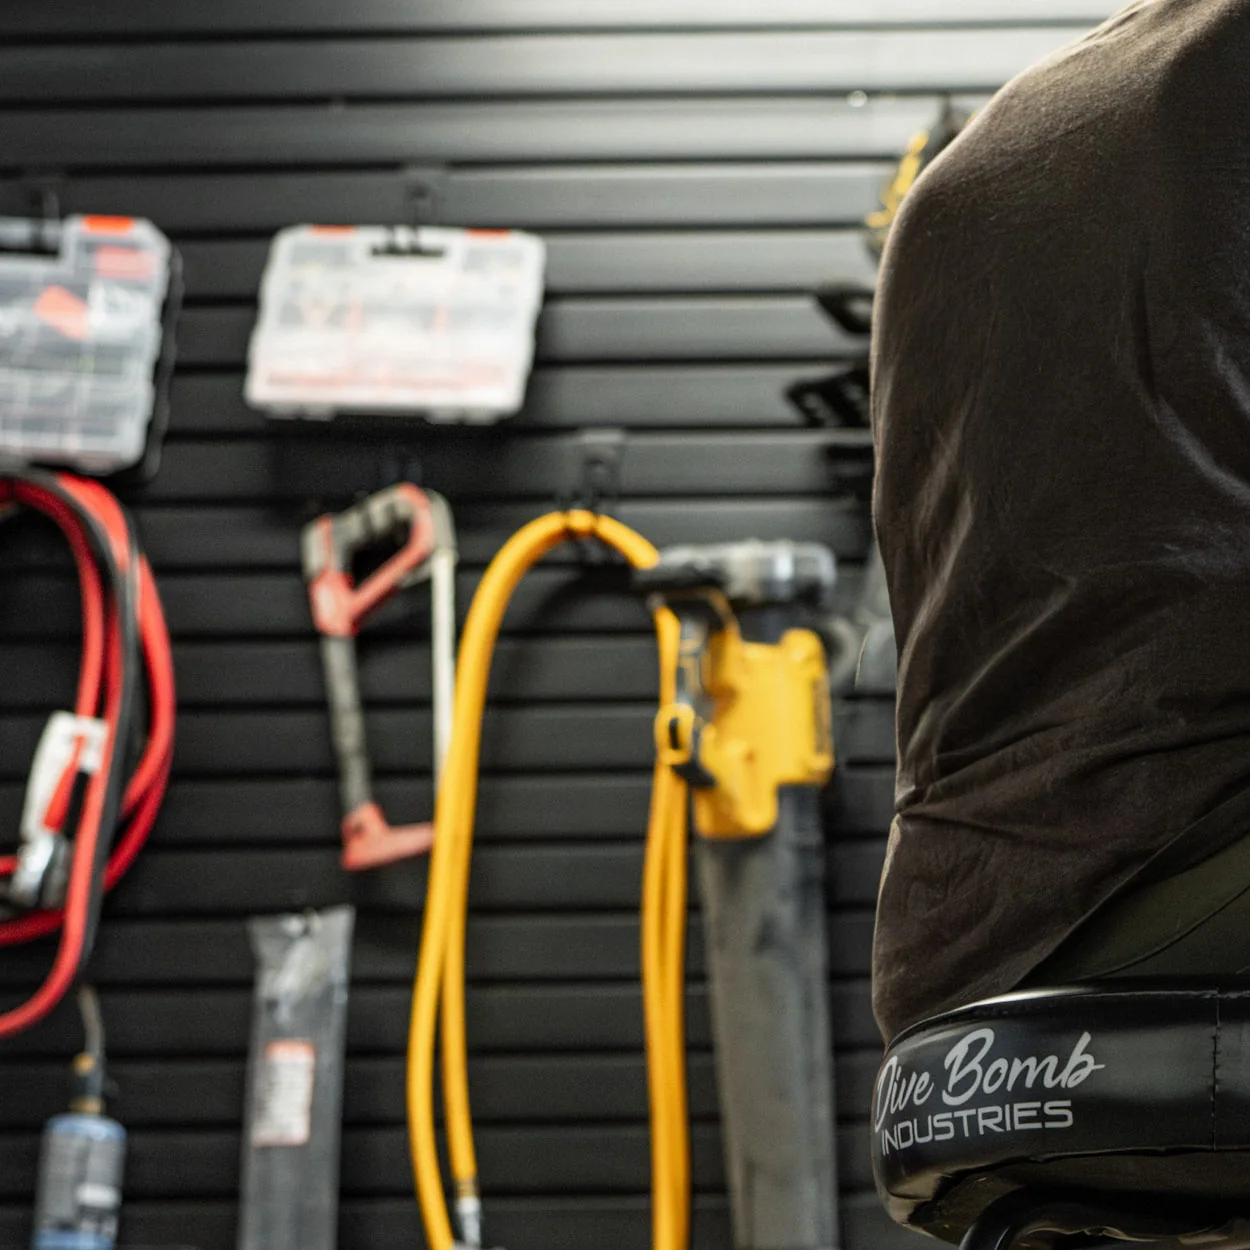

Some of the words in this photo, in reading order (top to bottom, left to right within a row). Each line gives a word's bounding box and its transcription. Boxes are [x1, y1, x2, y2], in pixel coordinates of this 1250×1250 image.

[874, 1055, 934, 1134] Dive
[942, 1027, 1106, 1106] Bomb
[881, 1099, 1074, 1157] INDUSTRIES
